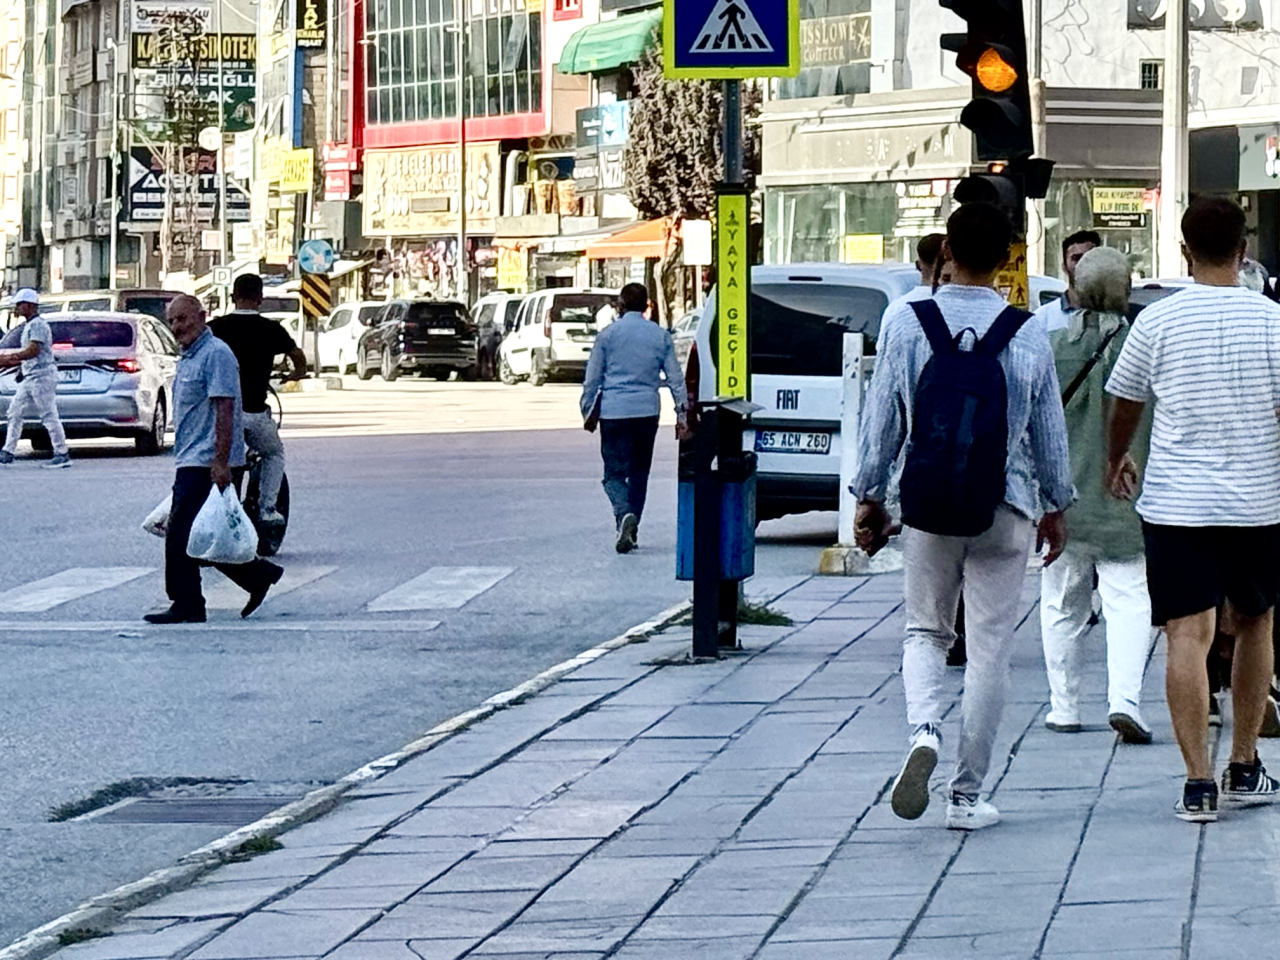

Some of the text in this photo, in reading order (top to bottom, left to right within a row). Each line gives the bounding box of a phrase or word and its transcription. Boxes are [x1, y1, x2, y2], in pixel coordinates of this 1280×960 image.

[727, 228, 739, 289] YAYA
[776, 389, 801, 410] FIAT
[762, 432, 776, 446] 65
[806, 434, 829, 449] 260
